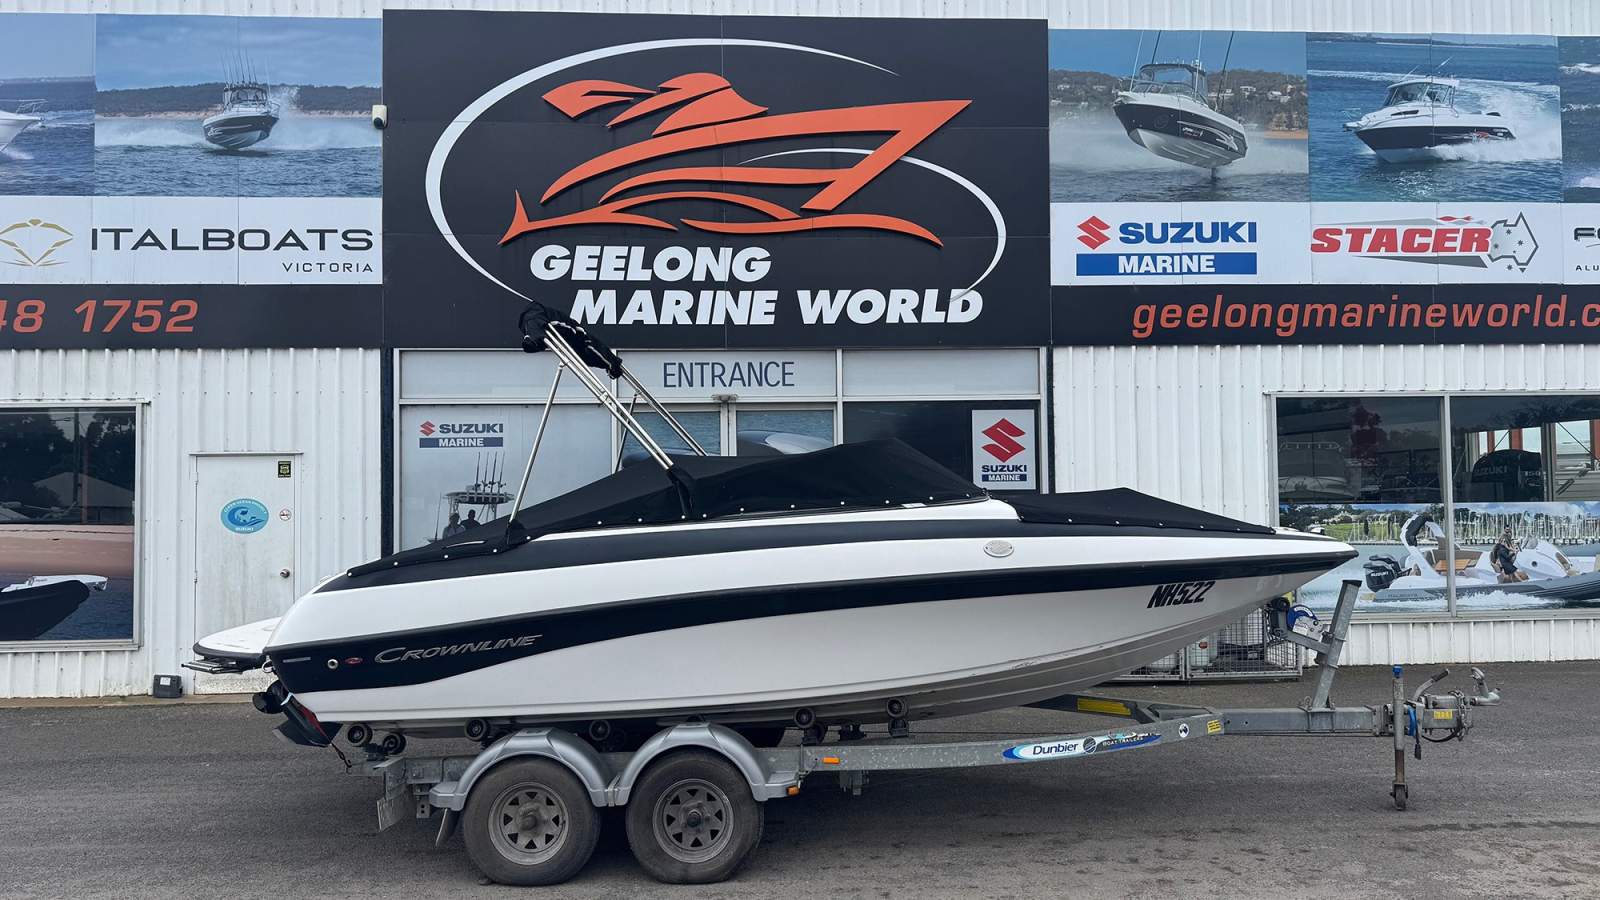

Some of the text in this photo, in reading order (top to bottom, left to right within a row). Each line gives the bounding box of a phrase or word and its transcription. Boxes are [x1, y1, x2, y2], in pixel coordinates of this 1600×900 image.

[92, 228, 373, 251] ITALBOATS
[1119, 222, 1257, 244] SUZUKI
[1311, 228, 1492, 253] STACER
[282, 262, 373, 273] VICTORIA
[530, 244, 771, 282] GEELONG
[1118, 254, 1216, 274] MARINE
[0, 299, 198, 333] 8 1752
[570, 288, 983, 325] MARINE WORLD
[663, 360, 795, 388] ENTRANCE
[439, 423, 504, 434] SUZUKI
[438, 438, 484, 447] MARINE
[981, 464, 1027, 473] SUZUKI
[1146, 580, 1217, 609] NH522
[1032, 741, 1079, 756] Dunbier
